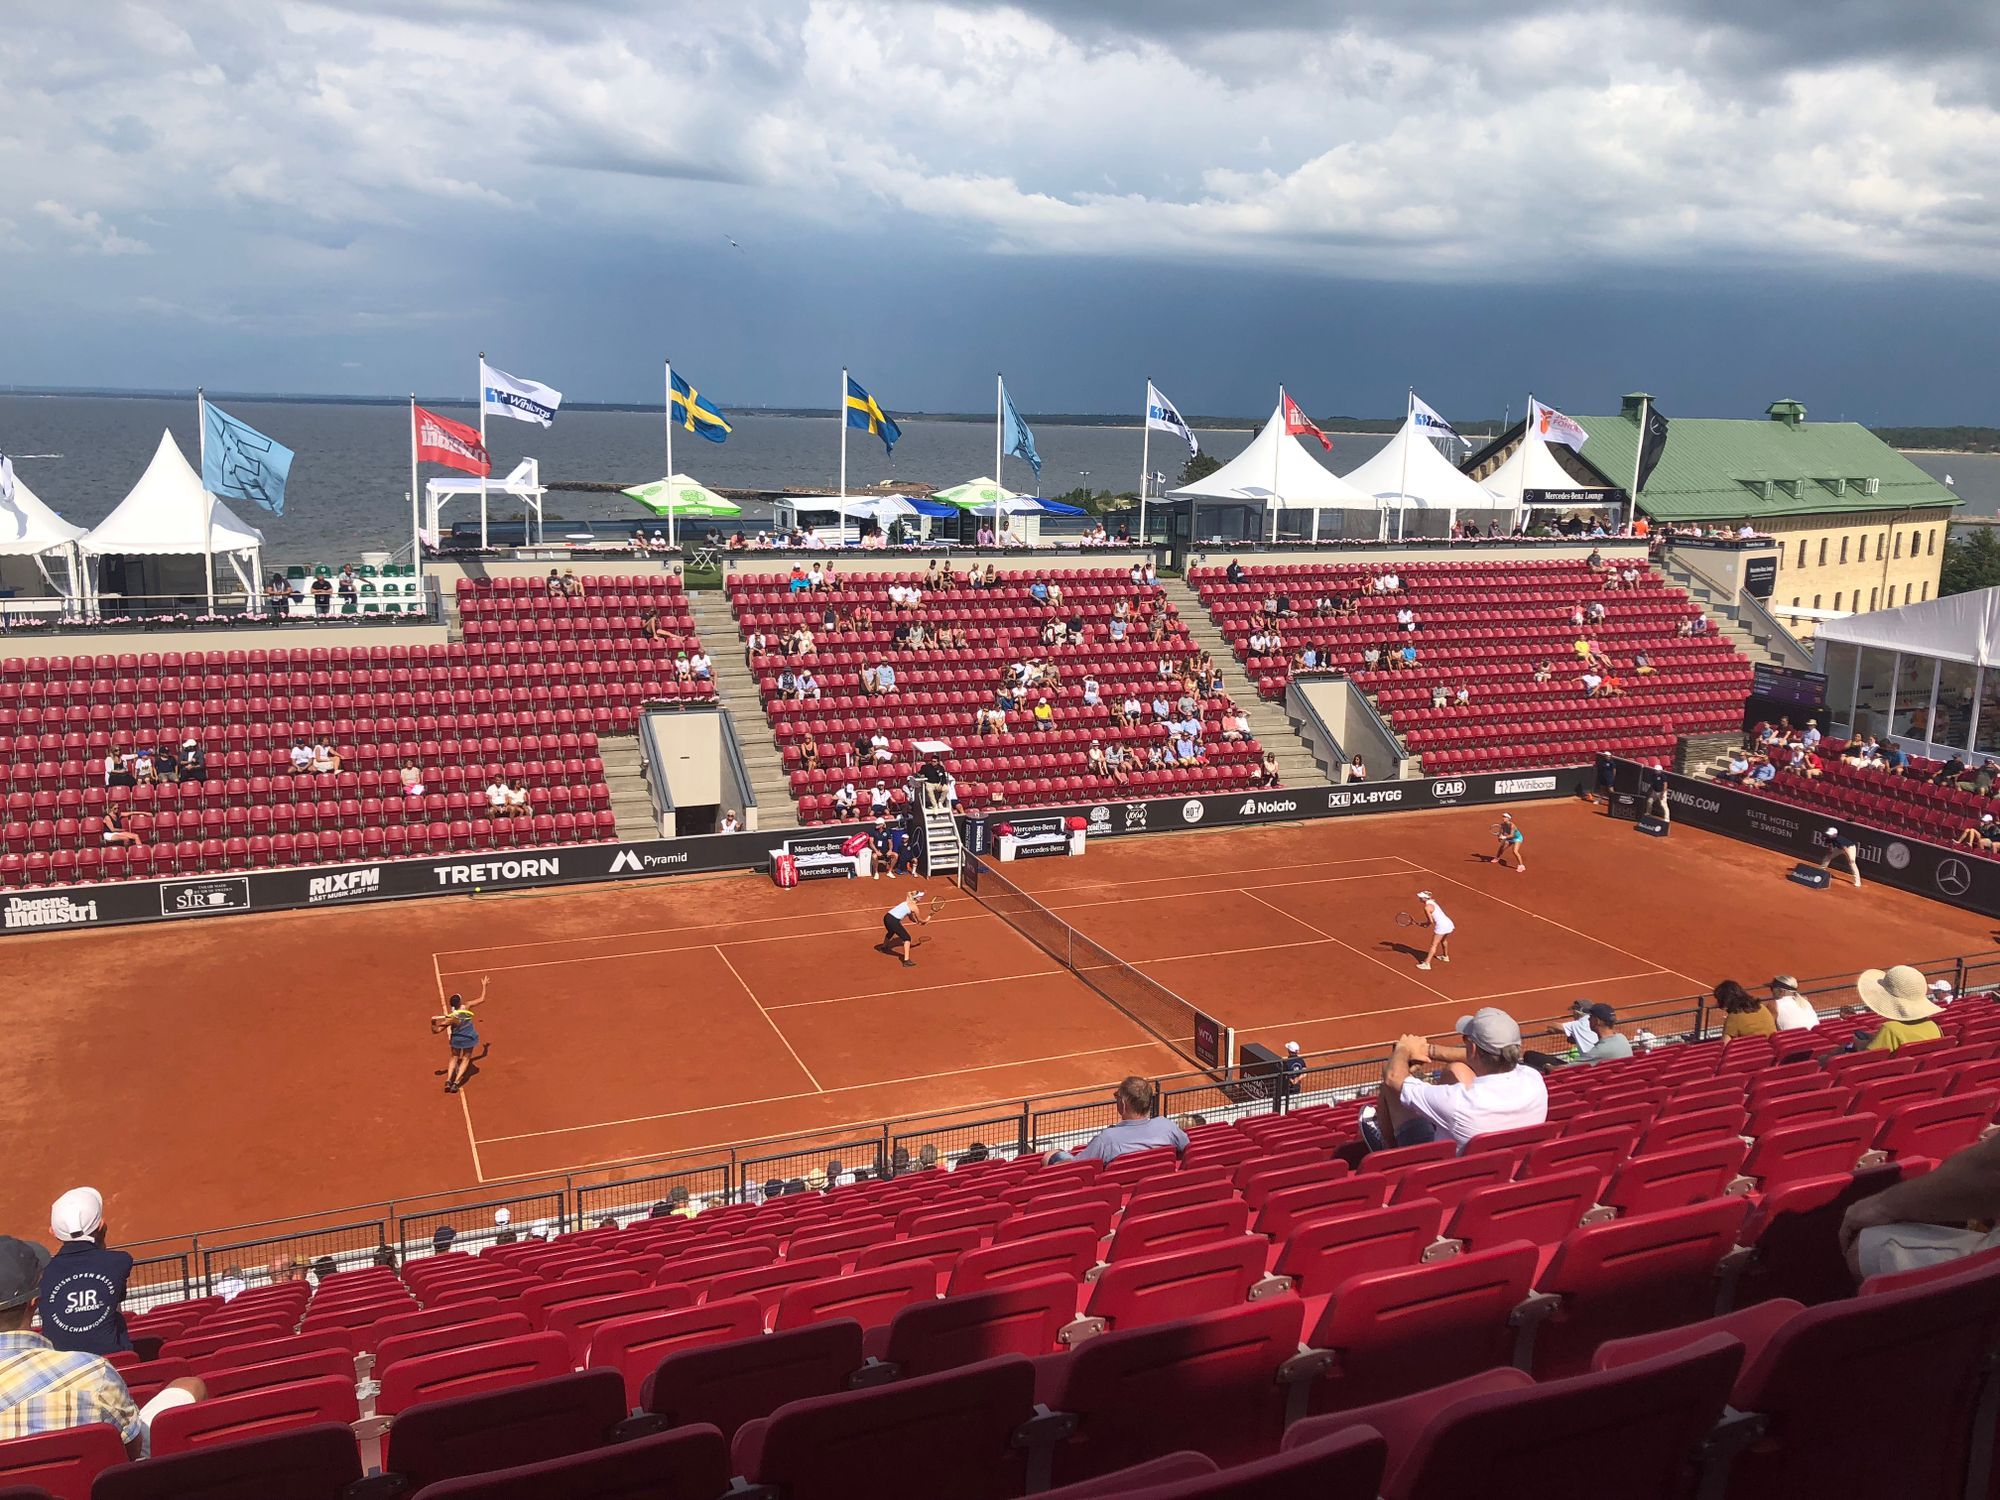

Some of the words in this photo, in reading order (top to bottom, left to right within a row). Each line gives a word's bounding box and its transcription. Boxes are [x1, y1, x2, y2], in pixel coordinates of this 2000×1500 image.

[1435, 782, 1463, 795] EAB
[1352, 790, 1402, 804] XL-BYGG
[1258, 800, 1297, 814] Nolato
[1747, 809, 1767, 820] ELITE
[1769, 816, 1799, 830] HOTELS
[1013, 824, 1056, 832] Mercedes-Benz
[1760, 822, 1792, 837] SWEDEN
[794, 843, 841, 853] Mercedes-Ben
[1021, 845, 1064, 855] Mercedes-Benz
[644, 852, 688, 866] Pyramid
[434, 857, 560, 885] TRETORN
[799, 866, 849, 876] Mercedes-Benz
[309, 867, 380, 896] RIXFM
[9, 896, 70, 912] Dagens
[176, 894, 206, 909] SIR
[4, 900, 98, 928] industri
[49, 1277, 71, 1303] SWEDISH
[72, 1272, 95, 1280] OPEN
[66, 1289, 97, 1308] SIR
[74, 1304, 100, 1313] SWEDEN
[51, 1313, 69, 1331] TENNIS
[69, 1305, 110, 1333] CHAMPIONSHIP
